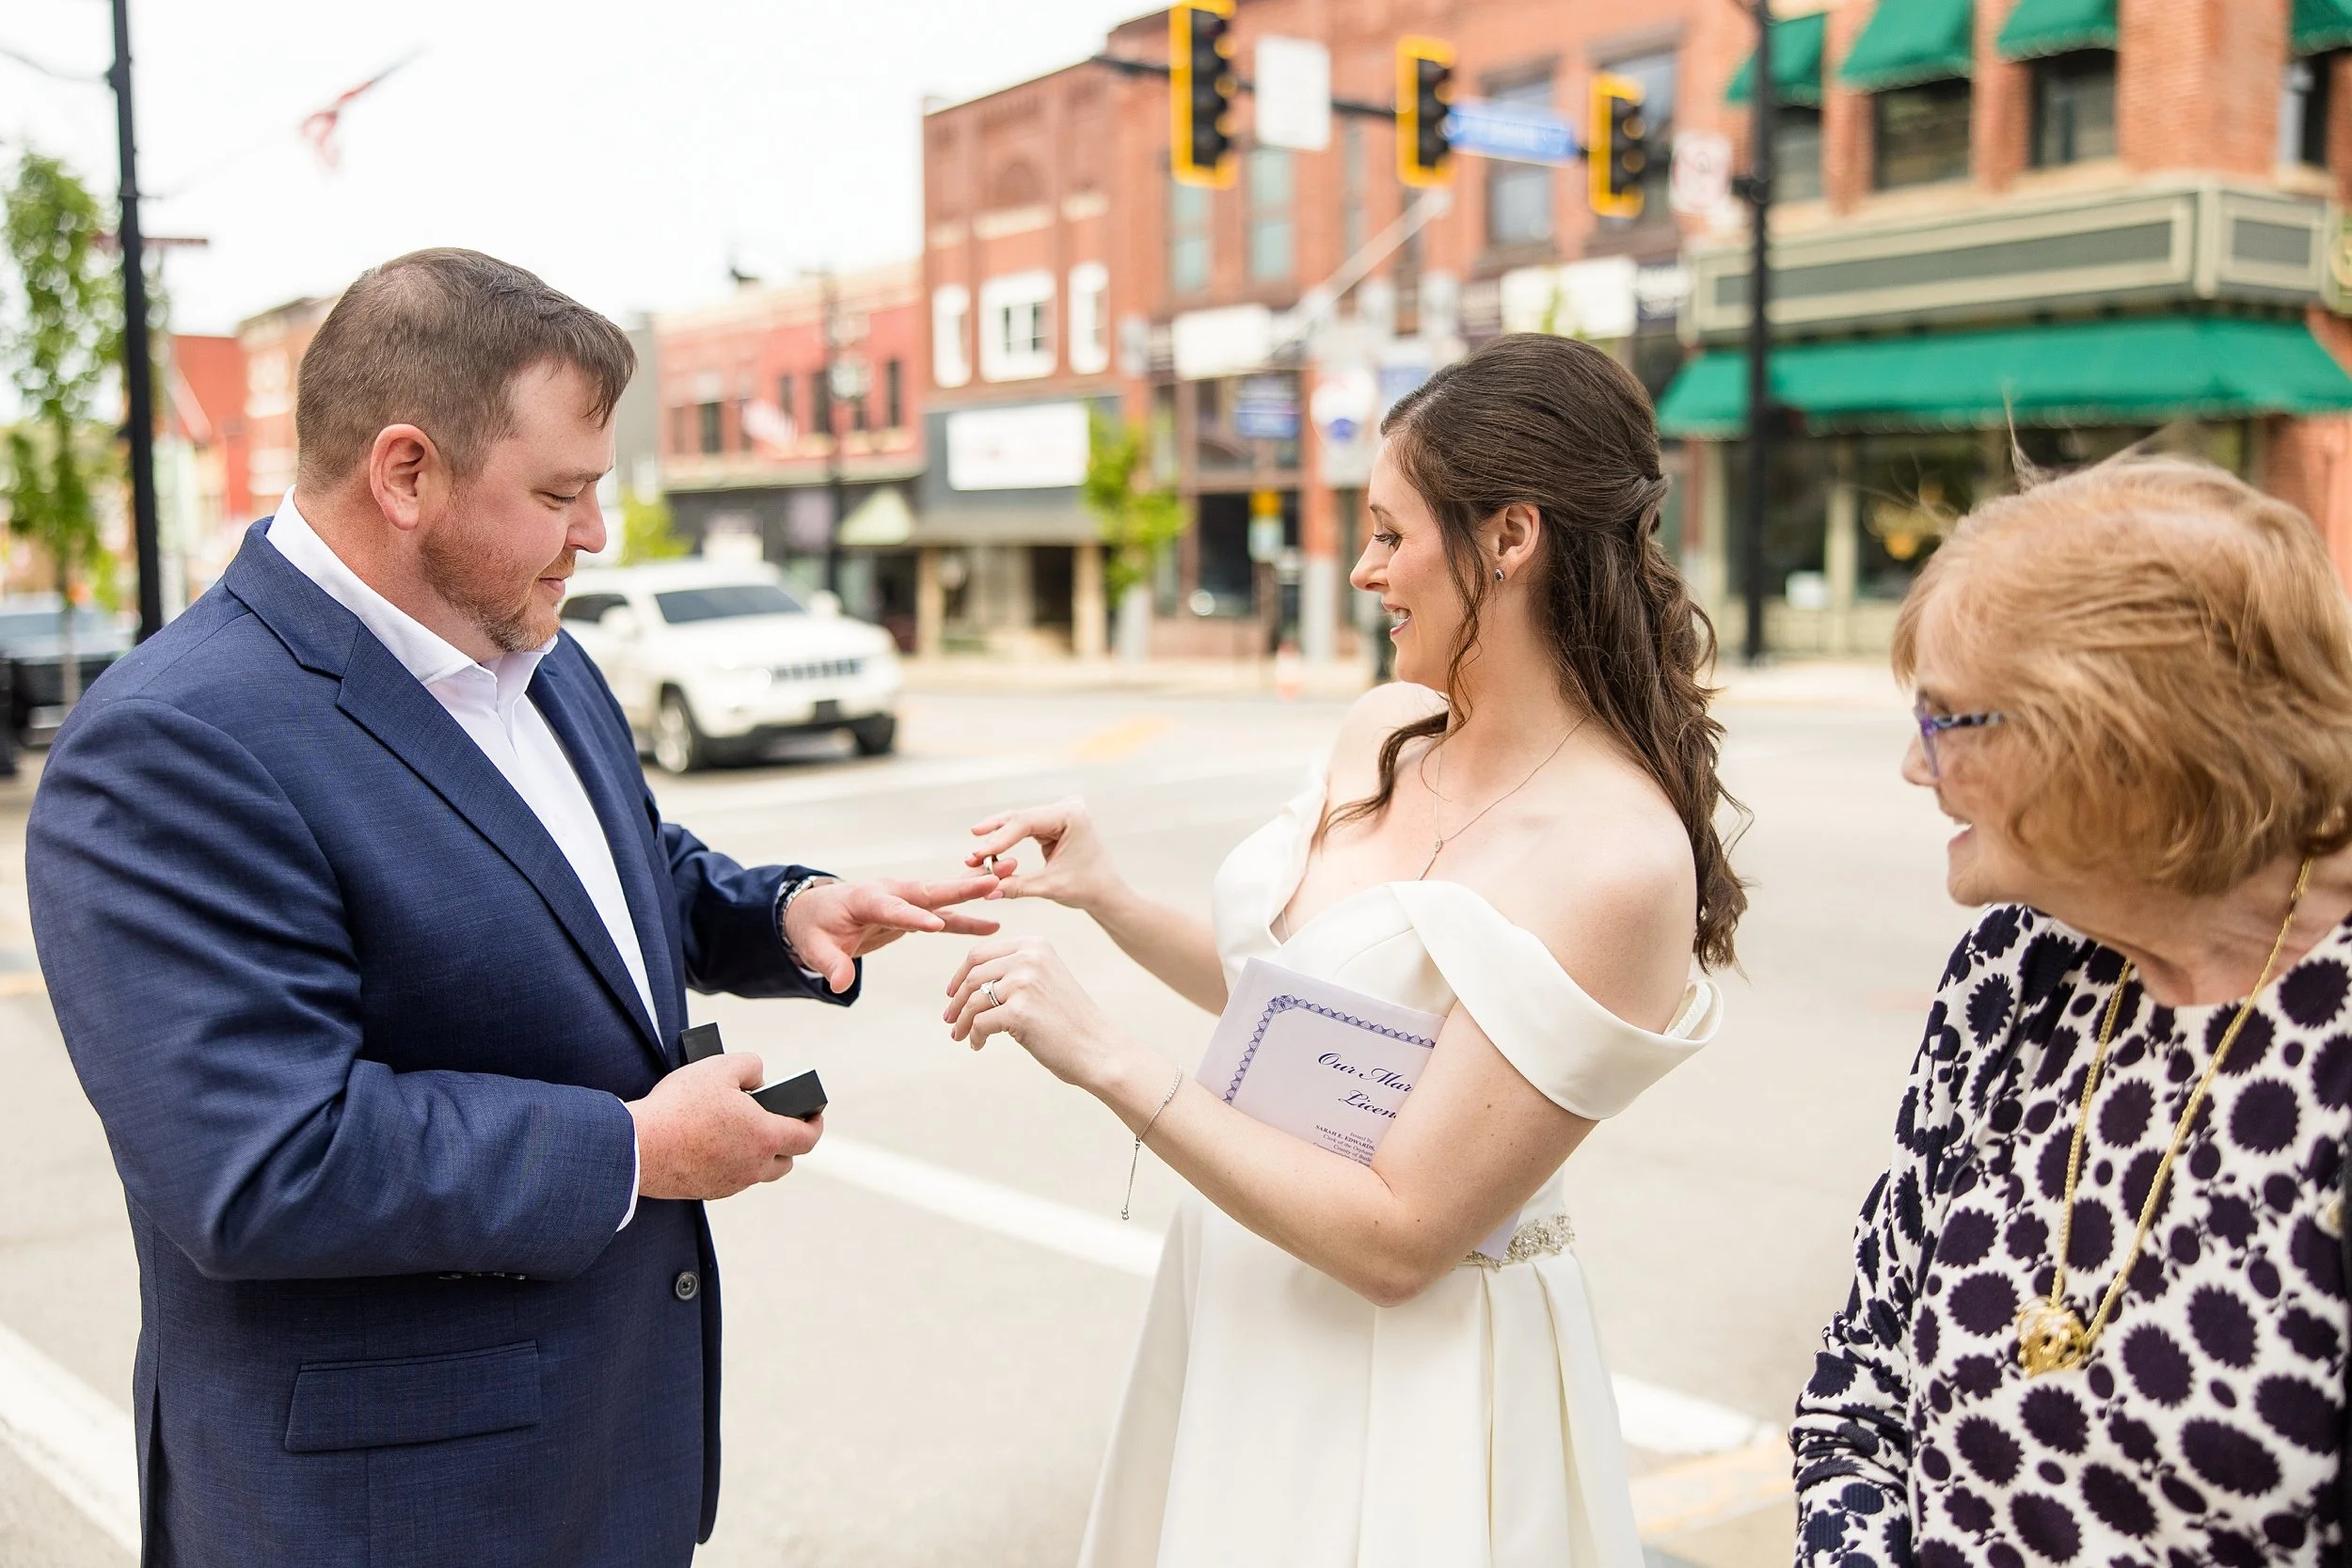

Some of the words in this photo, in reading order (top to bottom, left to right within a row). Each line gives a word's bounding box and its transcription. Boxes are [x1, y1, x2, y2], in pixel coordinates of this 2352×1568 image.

[1318, 1053, 1357, 1074] Our
[1359, 1068, 1413, 1092] Mar
[1338, 1089, 1396, 1118] Licen
[1315, 1124, 1337, 1136] SARAH
[1323, 1134, 1337, 1143] Clerk
[1333, 1144, 1351, 1155] County
